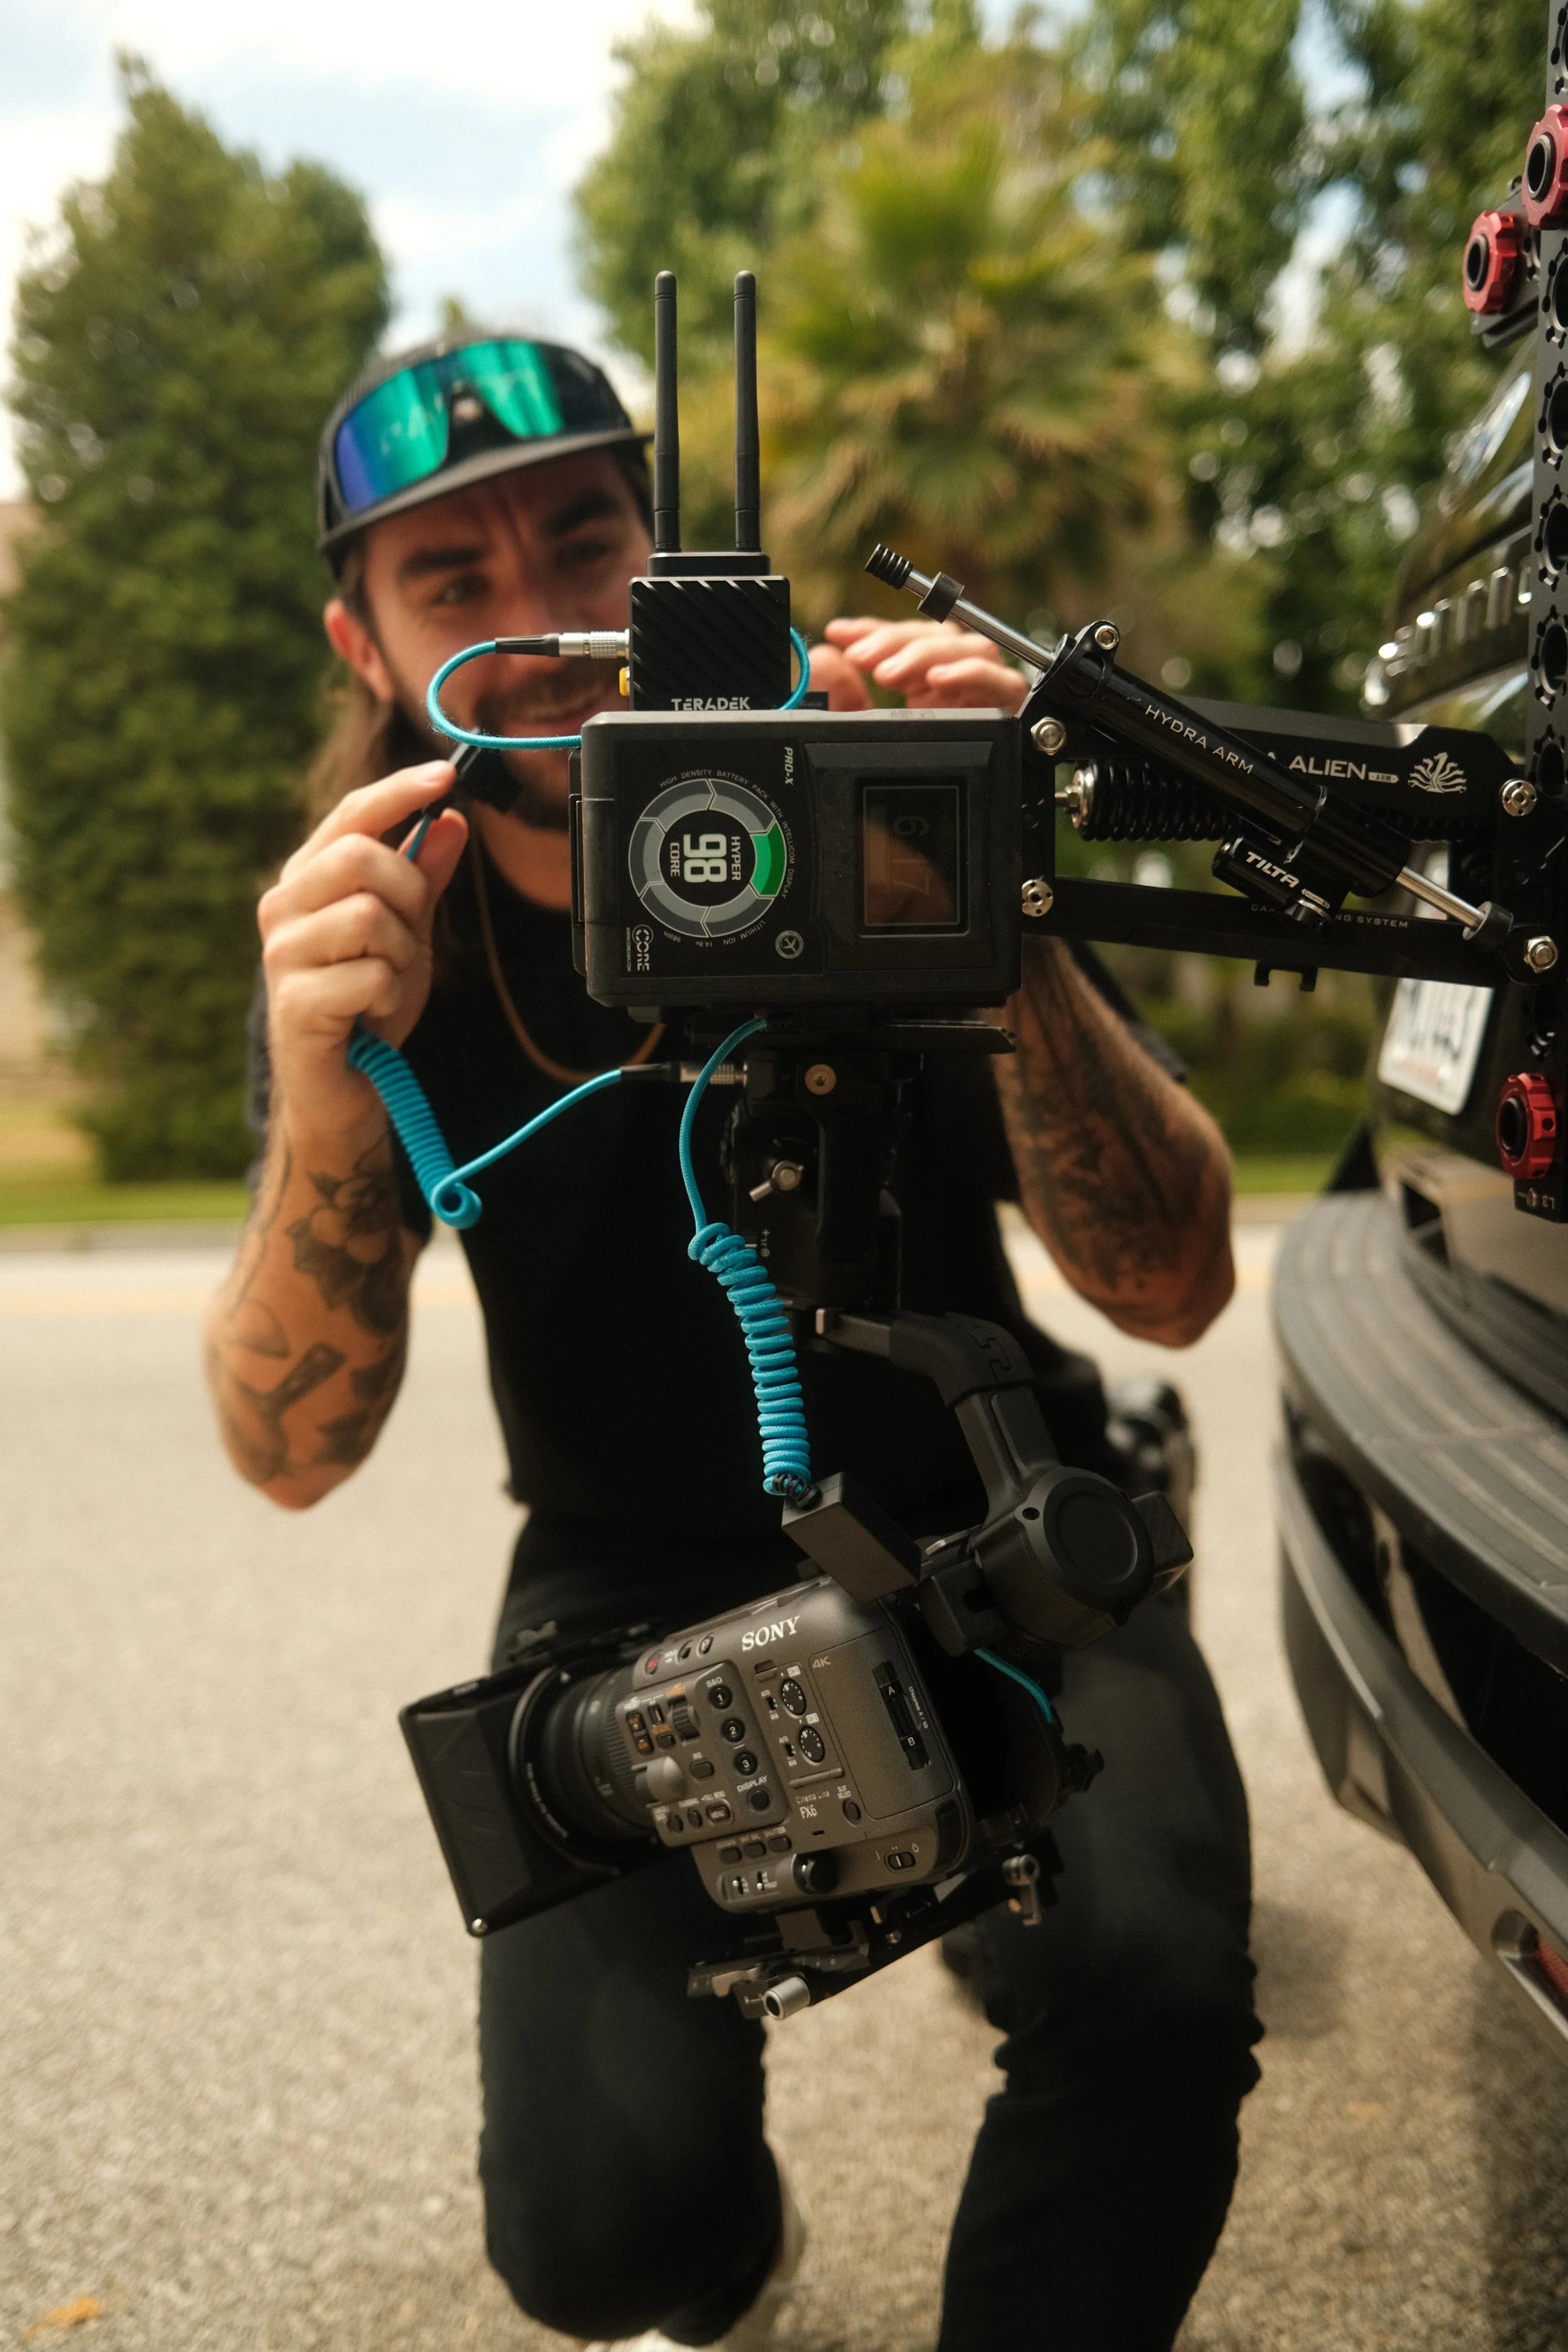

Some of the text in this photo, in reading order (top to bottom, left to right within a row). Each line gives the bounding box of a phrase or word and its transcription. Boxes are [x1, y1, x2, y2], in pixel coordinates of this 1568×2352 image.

[670, 697, 751, 711] TERADEK
[1145, 704, 1254, 775] HYDRA ARM
[784, 746, 793, 786] PRO-X
[1288, 755, 1367, 780] ALIEN
[659, 769, 795, 899] HIGH DENSITY BATTERY PACK WITH INTELLICOM DISPLAY
[670, 842, 681, 877] CORE
[683, 833, 727, 883] 98
[731, 835, 741, 881] HYPER
[1246, 850, 1300, 888] TILTA
[1355, 914, 1408, 928] SYSTEM
[739, 919, 766, 941] LITHIUM
[723, 938, 736, 946] ION
[634, 927, 650, 972] CORE
[741, 1614, 801, 1651] SONY
[812, 1655, 832, 1668] 4K
[706, 1676, 723, 1687] S&Q
[717, 1693, 723, 1702] 1
[888, 1686, 896, 1695] A
[729, 1726, 737, 1735] 2
[908, 1737, 916, 1746] B
[742, 1759, 750, 1768] 3
[736, 1775, 768, 1793] DISPLAY
[837, 1784, 847, 1793] SLOT
[795, 1790, 830, 1804] Cinema Line
[837, 1791, 852, 1799] SELECT
[799, 1804, 818, 1819] FX6
